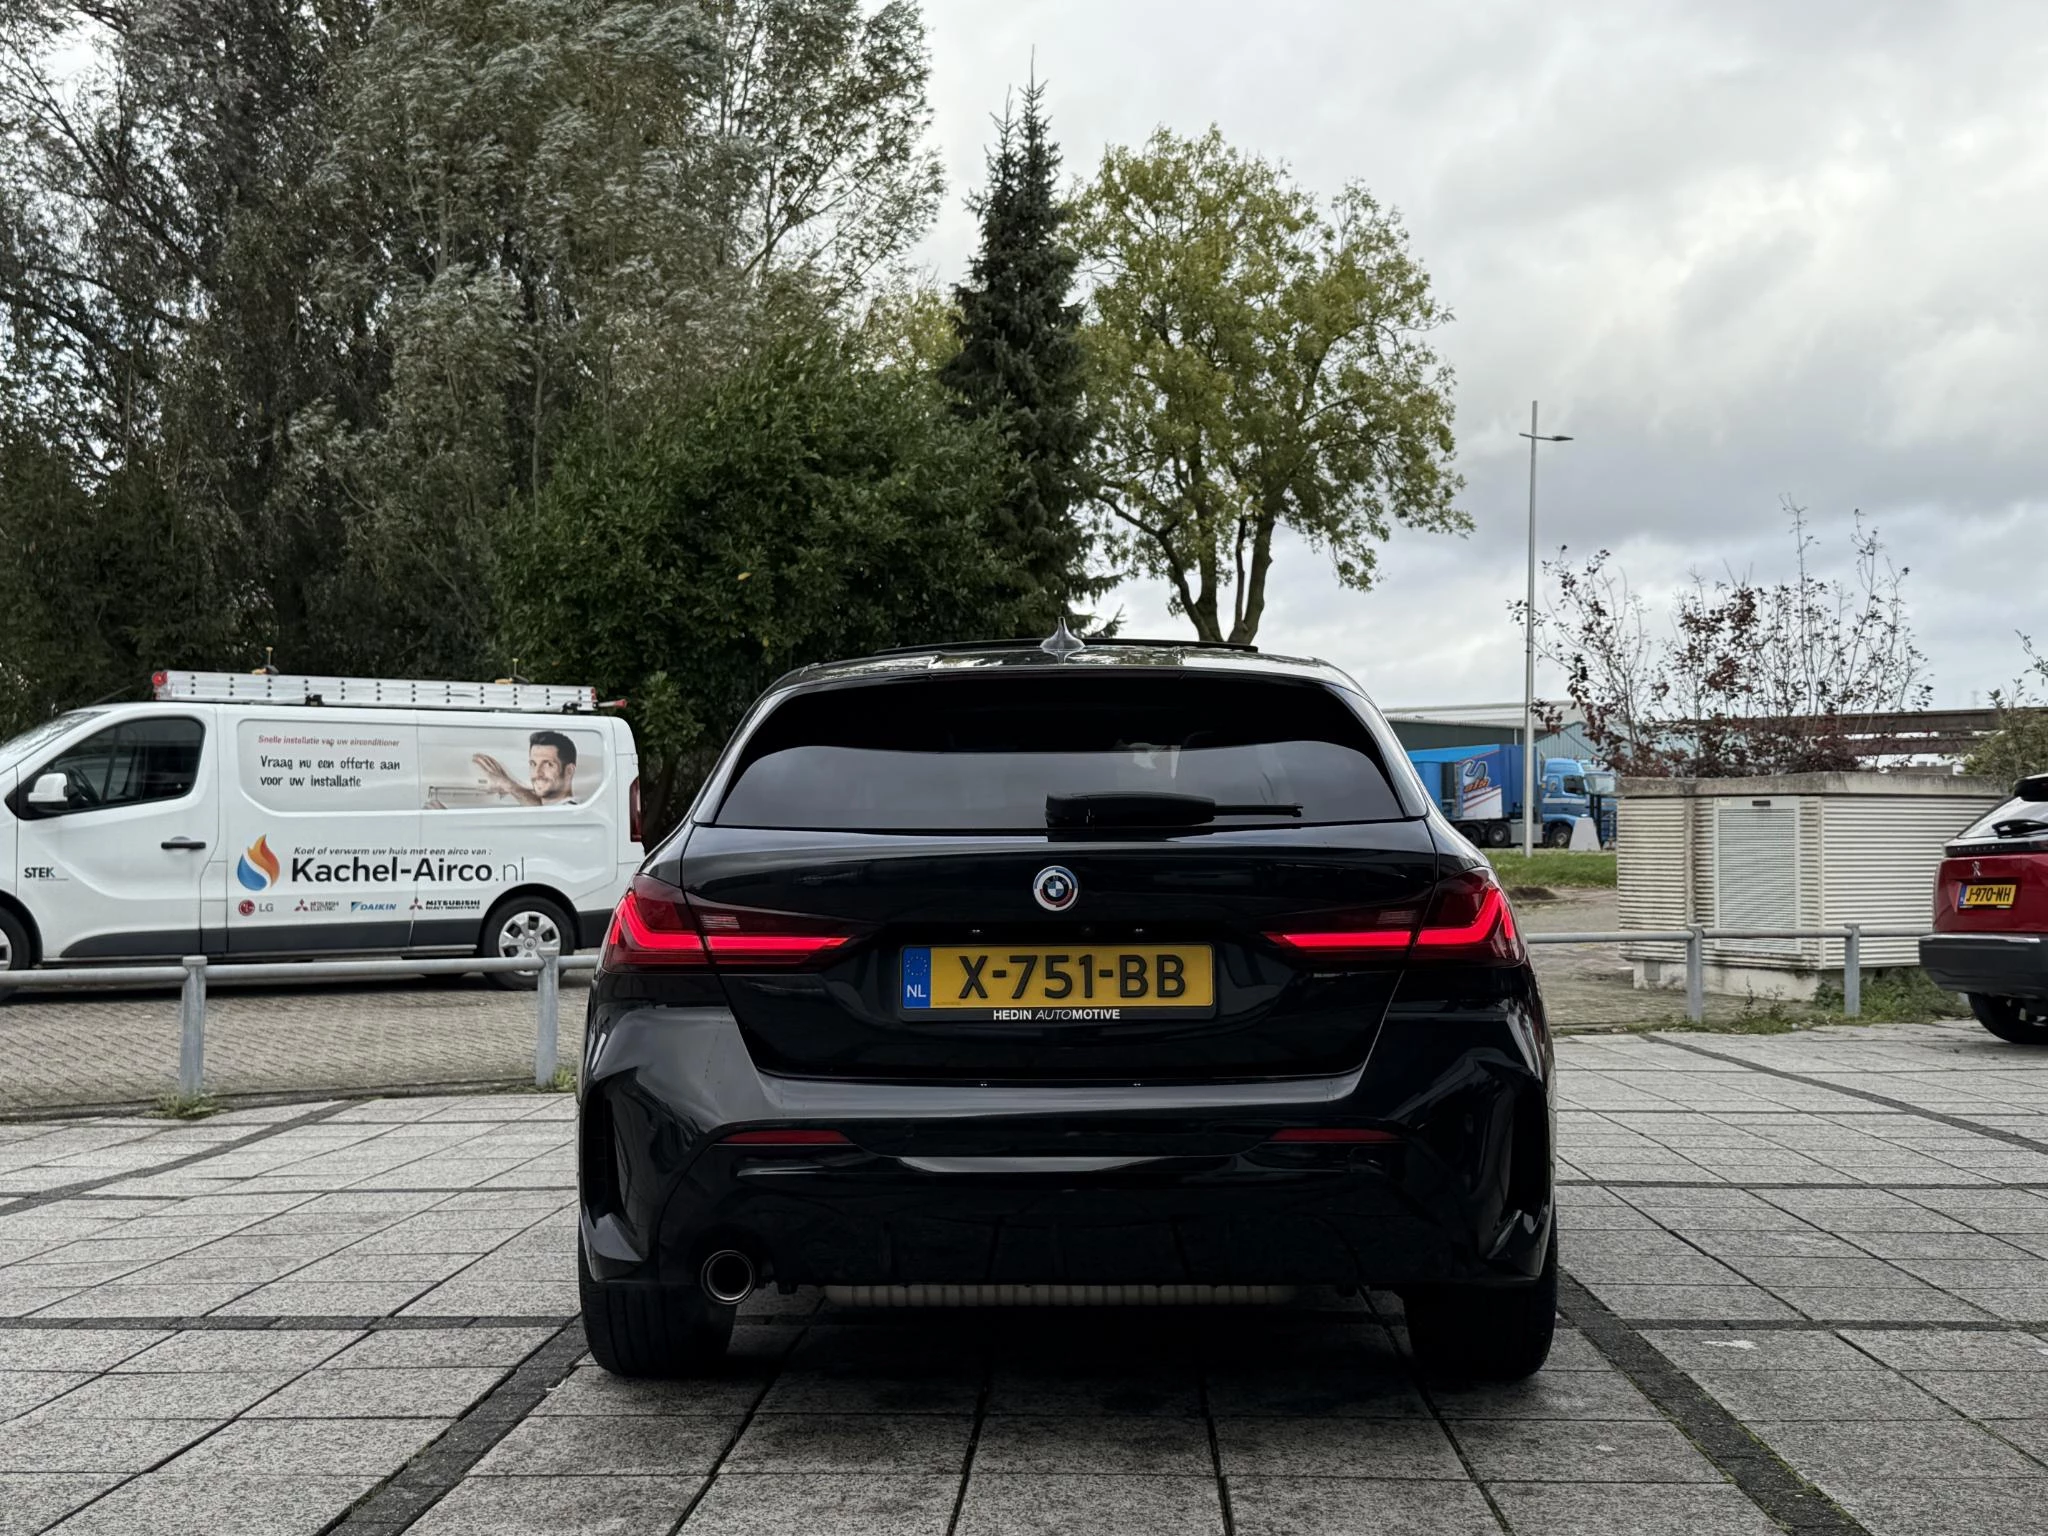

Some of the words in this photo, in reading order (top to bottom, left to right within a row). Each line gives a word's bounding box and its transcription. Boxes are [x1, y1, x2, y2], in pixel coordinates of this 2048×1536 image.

[258, 735, 281, 744] Snelle
[283, 736, 320, 745] installatie
[350, 738, 400, 747] airconditioner
[260, 755, 293, 770] Vraag
[299, 759, 312, 769] nu
[317, 759, 334, 769] een
[340, 757, 375, 770] offerte
[379, 760, 400, 770] aan
[260, 776, 283, 786] voor
[289, 777, 305, 786] uw
[310, 775, 362, 787] installatie
[294, 847, 315, 855] Koel
[317, 847, 328, 855] of
[389, 847, 407, 855] huis
[410, 847, 428, 855] met
[447, 847, 469, 855] airco
[24, 866, 55, 878] STEK
[292, 856, 524, 882] Kachel-Airco.nl
[1965, 887, 2012, 902] J-970-NH
[258, 903, 274, 912] LG
[360, 903, 397, 911] DAIKIN
[958, 954, 1187, 1000] X-751-BB
[906, 984, 927, 998] NL
[993, 1009, 1032, 1020] HEDIN
[1035, 1009, 1121, 1020] AUTOMOTIVE
